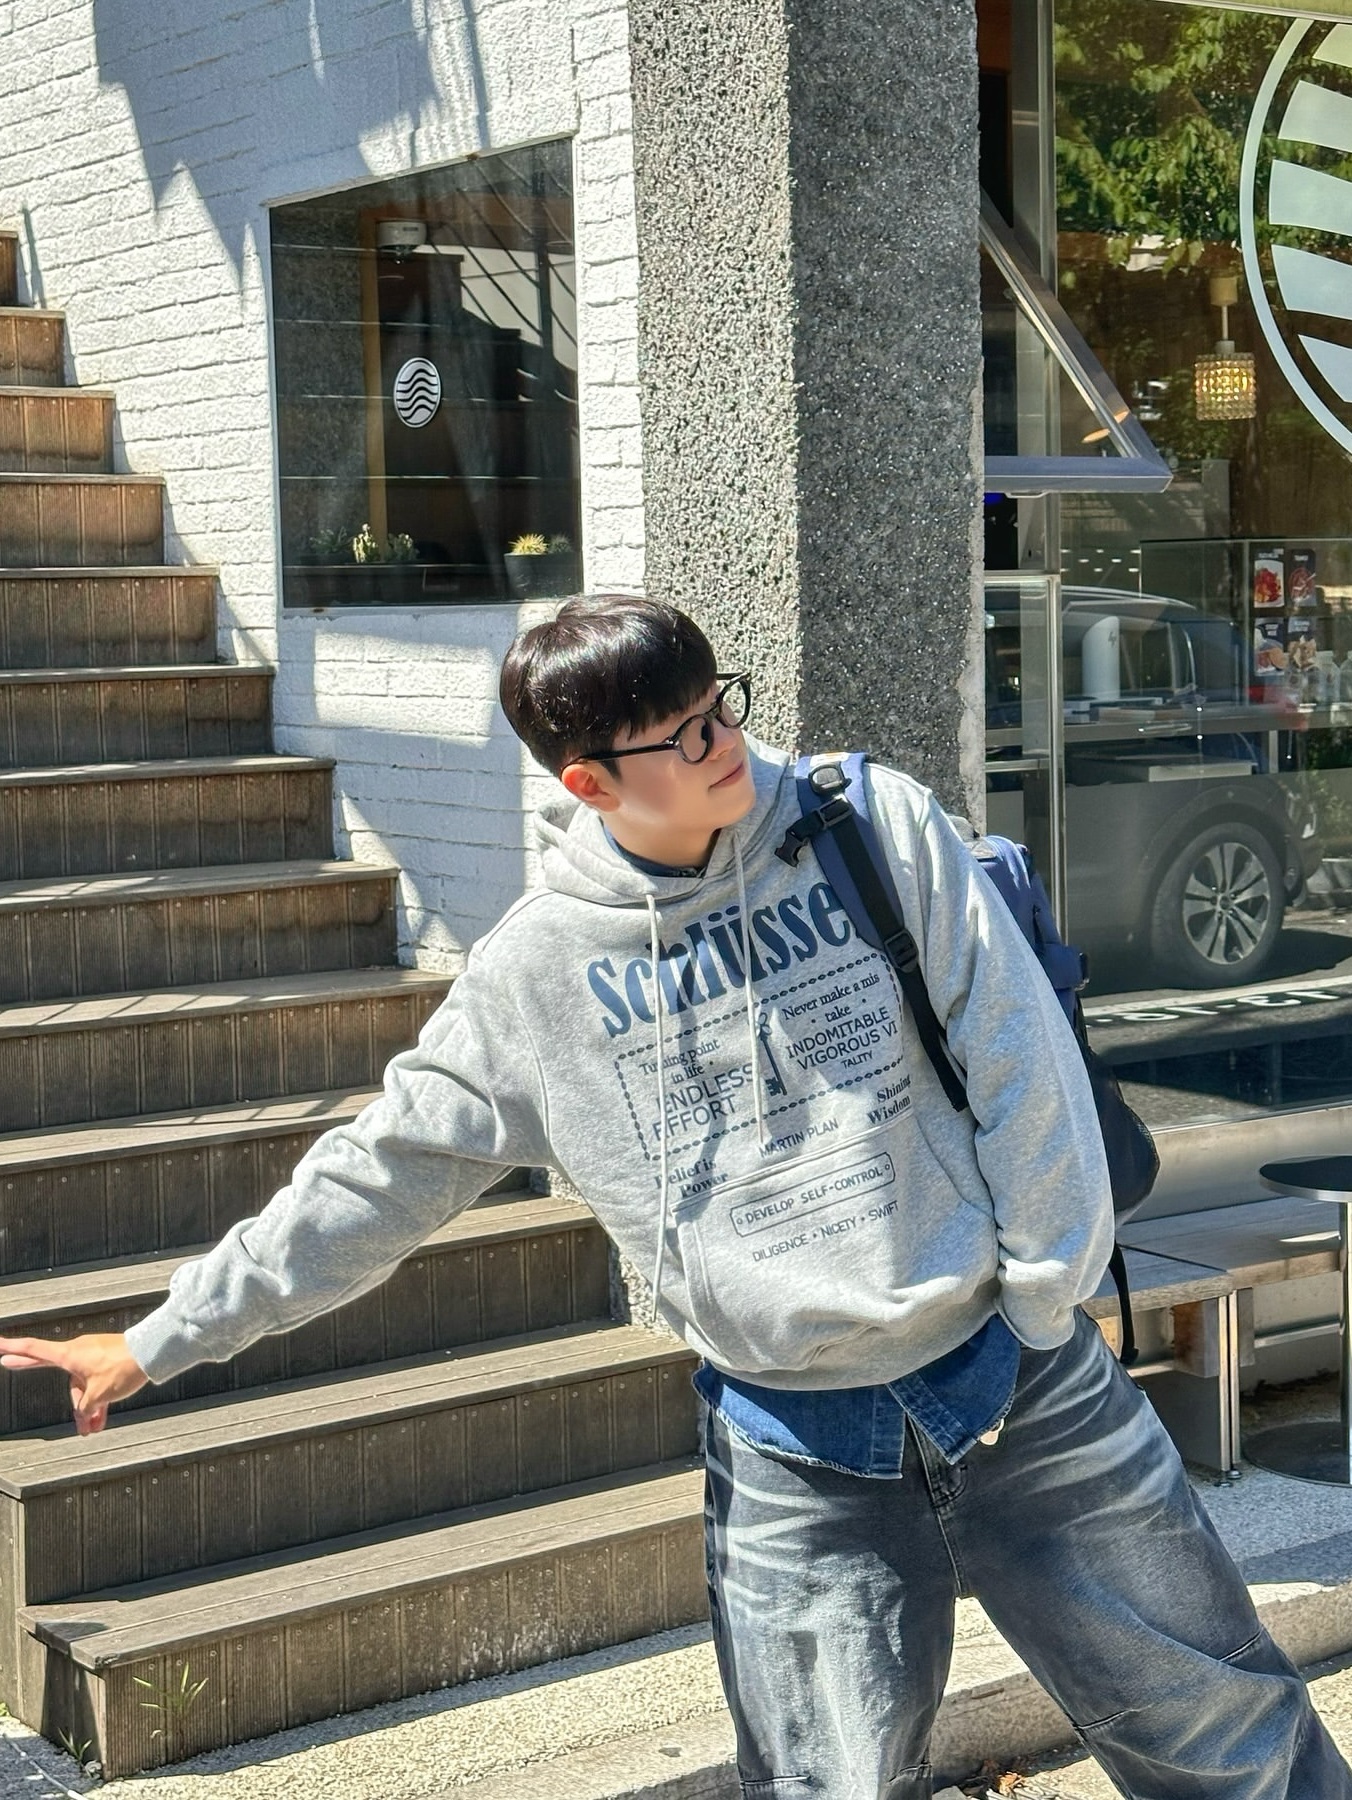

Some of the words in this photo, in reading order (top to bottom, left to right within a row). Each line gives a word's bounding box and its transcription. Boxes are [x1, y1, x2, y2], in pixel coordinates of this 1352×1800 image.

[587, 882, 861, 1038] Schlüsse
[782, 999, 818, 1020] Never
[820, 986, 852, 1005] make
[853, 982, 861, 993] a
[861, 972, 880, 988] mis
[825, 1005, 852, 1022] take
[786, 1006, 890, 1059] INDOMITABLE
[797, 1029, 880, 1070] VIGOROUS
[882, 1021, 899, 1037] VI
[688, 1039, 720, 1063] point
[841, 1050, 873, 1069] TALITY
[671, 1070, 684, 1084] in
[684, 1064, 705, 1080] life
[866, 1095, 911, 1125] Wisdom
[758, 1128, 805, 1157] MARTIN
[806, 1118, 839, 1139] PLAN
[702, 1158, 716, 1172] is
[679, 1173, 728, 1198] Power
[745, 1198, 794, 1224] DEVELOP
[801, 1166, 883, 1204] SELF-CONTROL
[752, 1233, 809, 1262] DILIGENCE
[820, 1216, 857, 1239] NICETY
[868, 1200, 899, 1222] SWIFT
